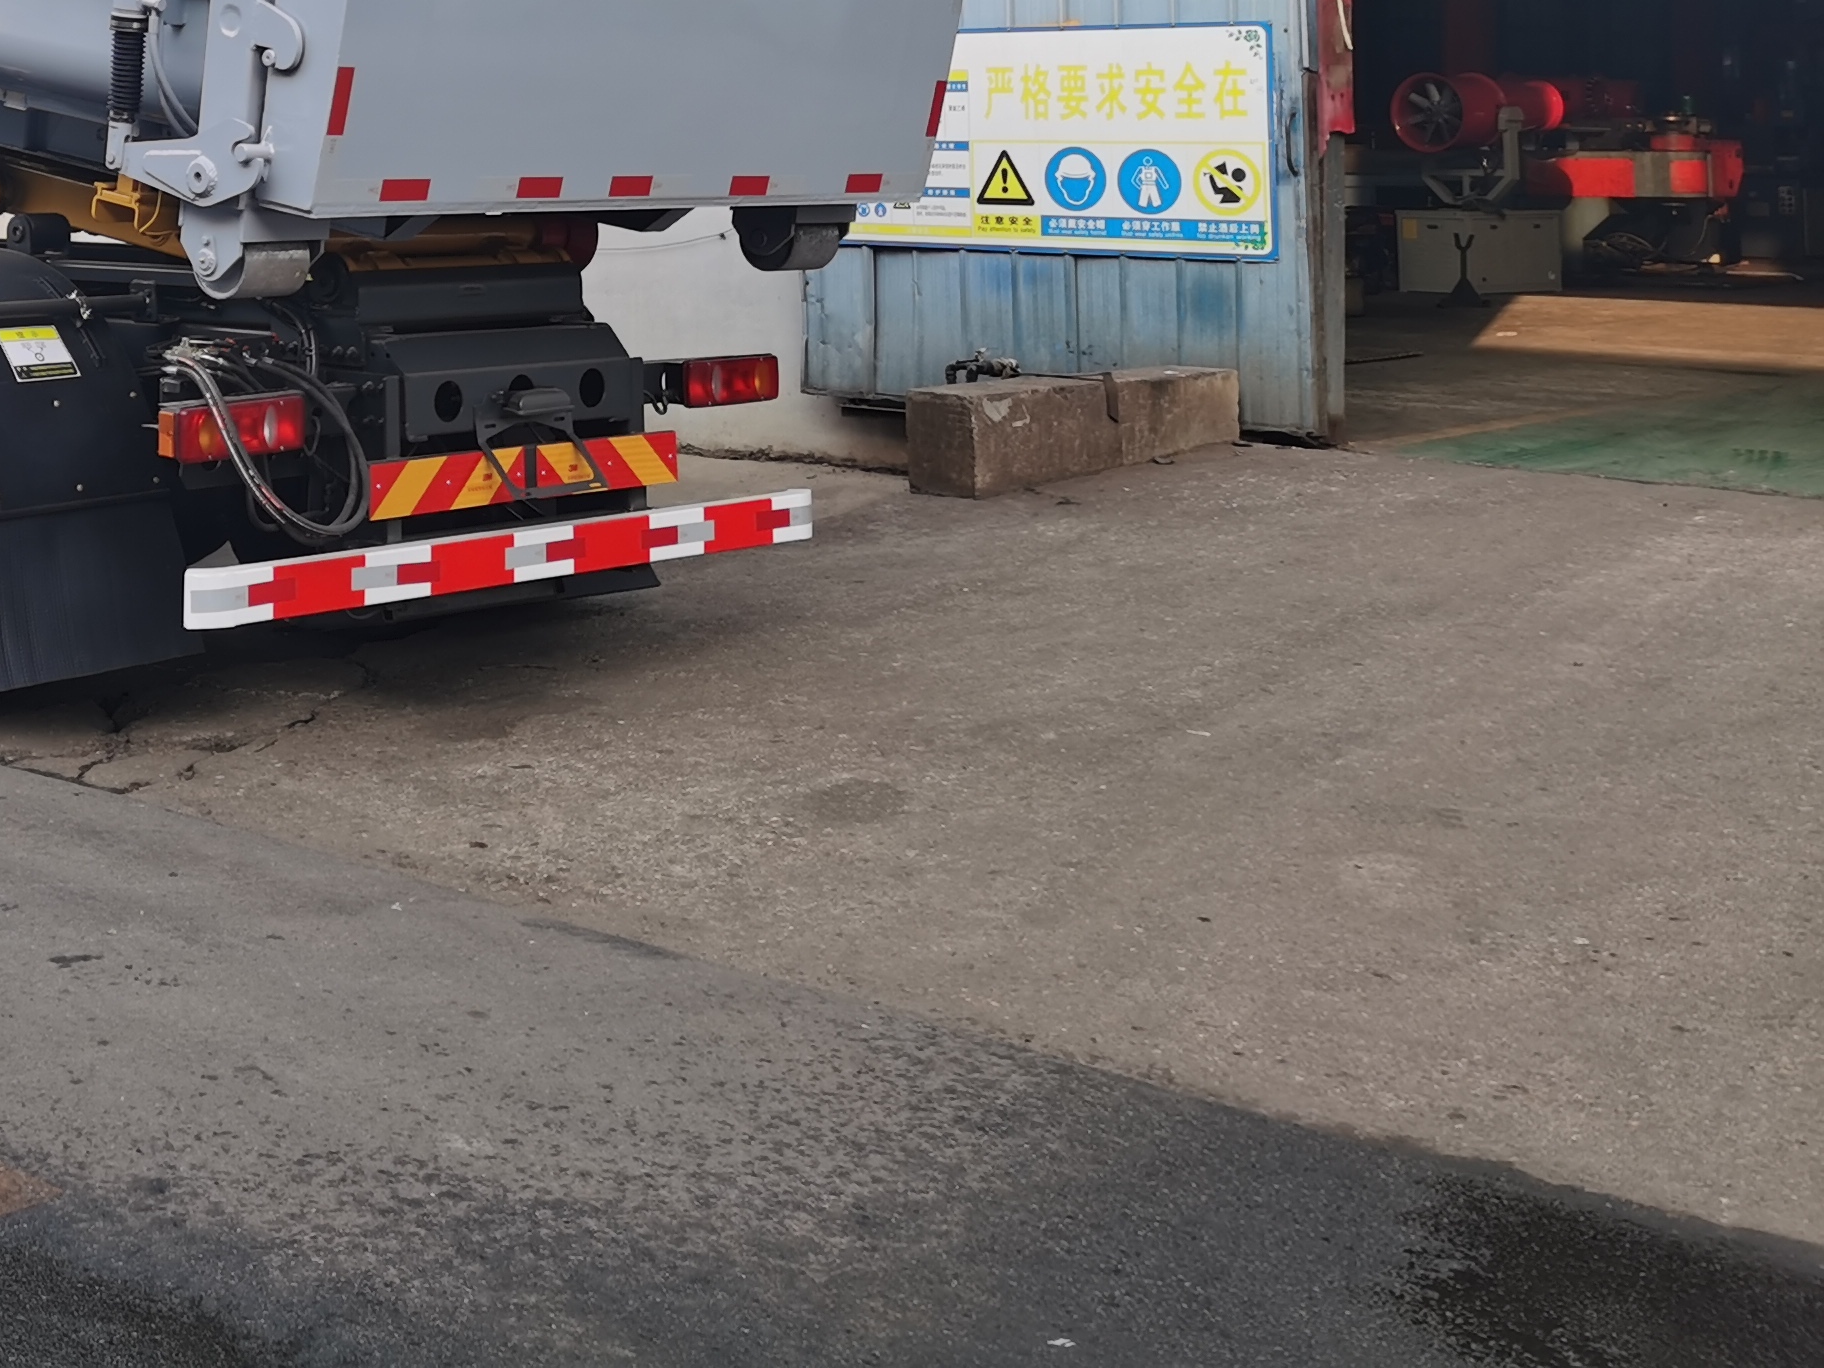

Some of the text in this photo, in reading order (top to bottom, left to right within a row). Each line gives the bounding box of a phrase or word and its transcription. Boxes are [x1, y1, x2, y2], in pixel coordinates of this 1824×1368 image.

[984, 60, 1249, 121] 严格要求安全在
